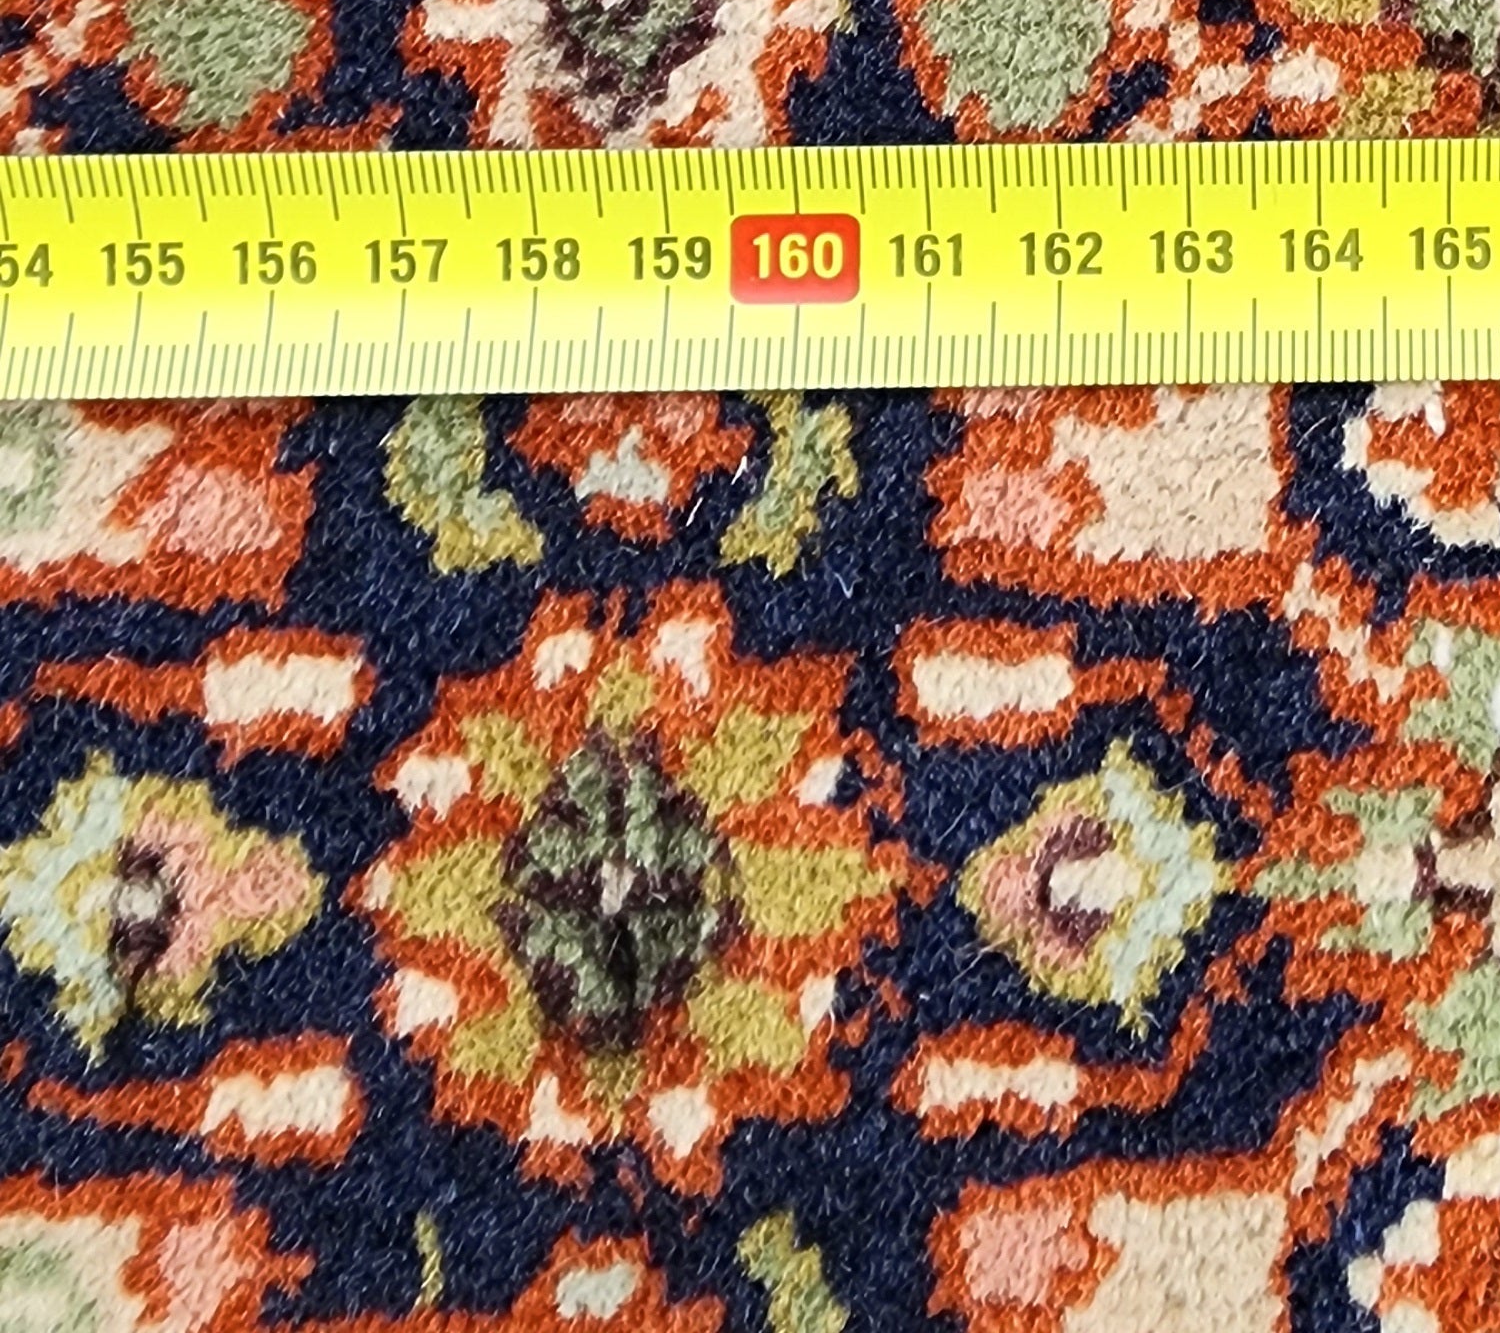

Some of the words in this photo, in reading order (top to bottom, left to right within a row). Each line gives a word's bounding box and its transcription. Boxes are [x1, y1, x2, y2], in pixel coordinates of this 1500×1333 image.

[100, 242, 185, 287] 155
[232, 241, 317, 286] 156
[364, 239, 449, 284] 157
[495, 238, 581, 282] 158
[627, 236, 712, 280] 159
[752, 233, 844, 280] 160
[889, 233, 964, 278] 161
[1019, 231, 1103, 276] 162
[1149, 230, 1233, 274] 163
[1279, 228, 1364, 272] 164
[1408, 226, 1492, 270] 165
